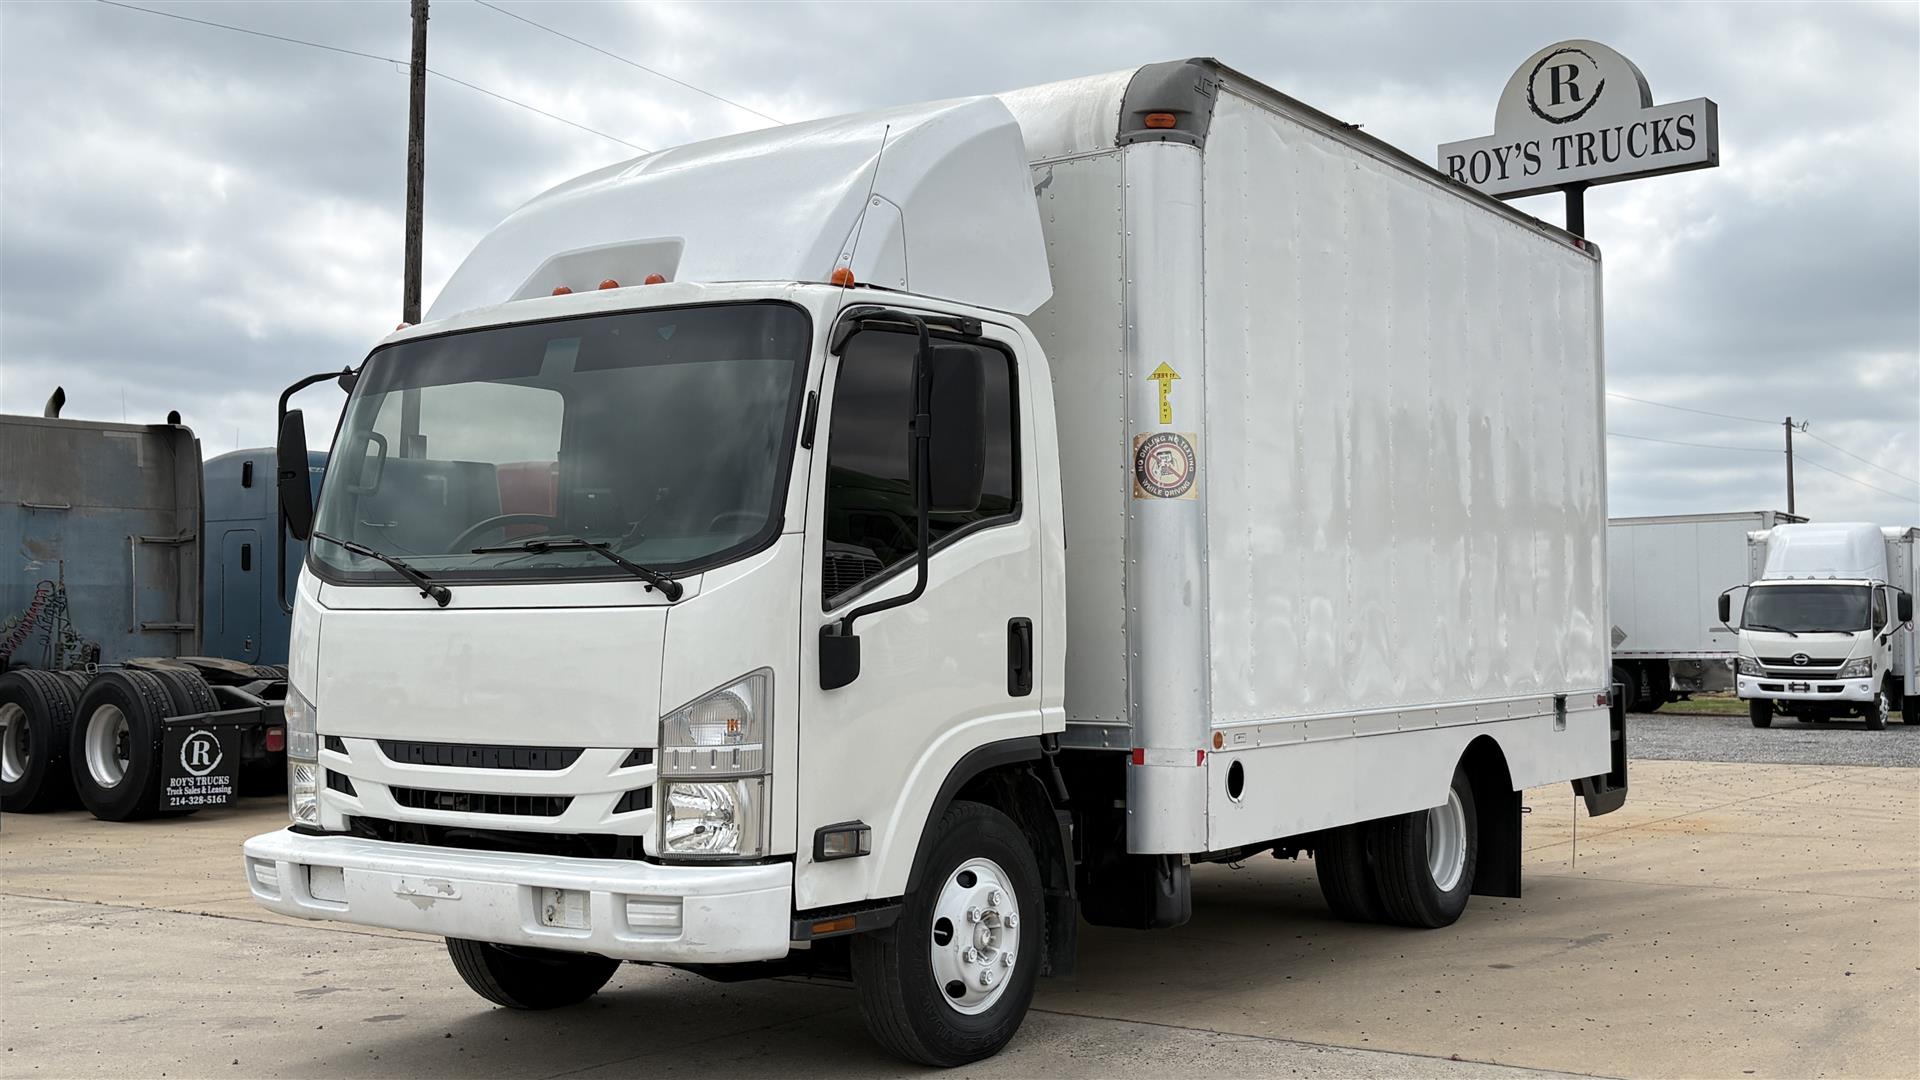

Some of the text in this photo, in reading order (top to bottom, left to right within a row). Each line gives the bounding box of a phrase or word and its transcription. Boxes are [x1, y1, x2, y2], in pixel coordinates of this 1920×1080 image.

[1547, 64, 1584, 106] R
[1447, 114, 1696, 185] ROY'S TRUCKS
[1140, 436, 1166, 458] DIALING
[1180, 440, 1194, 472] TEXTING
[1137, 461, 1144, 472] NO
[1142, 480, 1191, 496] WHILE DRIVING
[190, 740, 211, 765] R
[170, 776, 230, 787] ROY'S TRUCKS
[184, 787, 200, 795] Sales
[207, 785, 232, 795] Leasing
[170, 795, 226, 805] 214-328-5161
